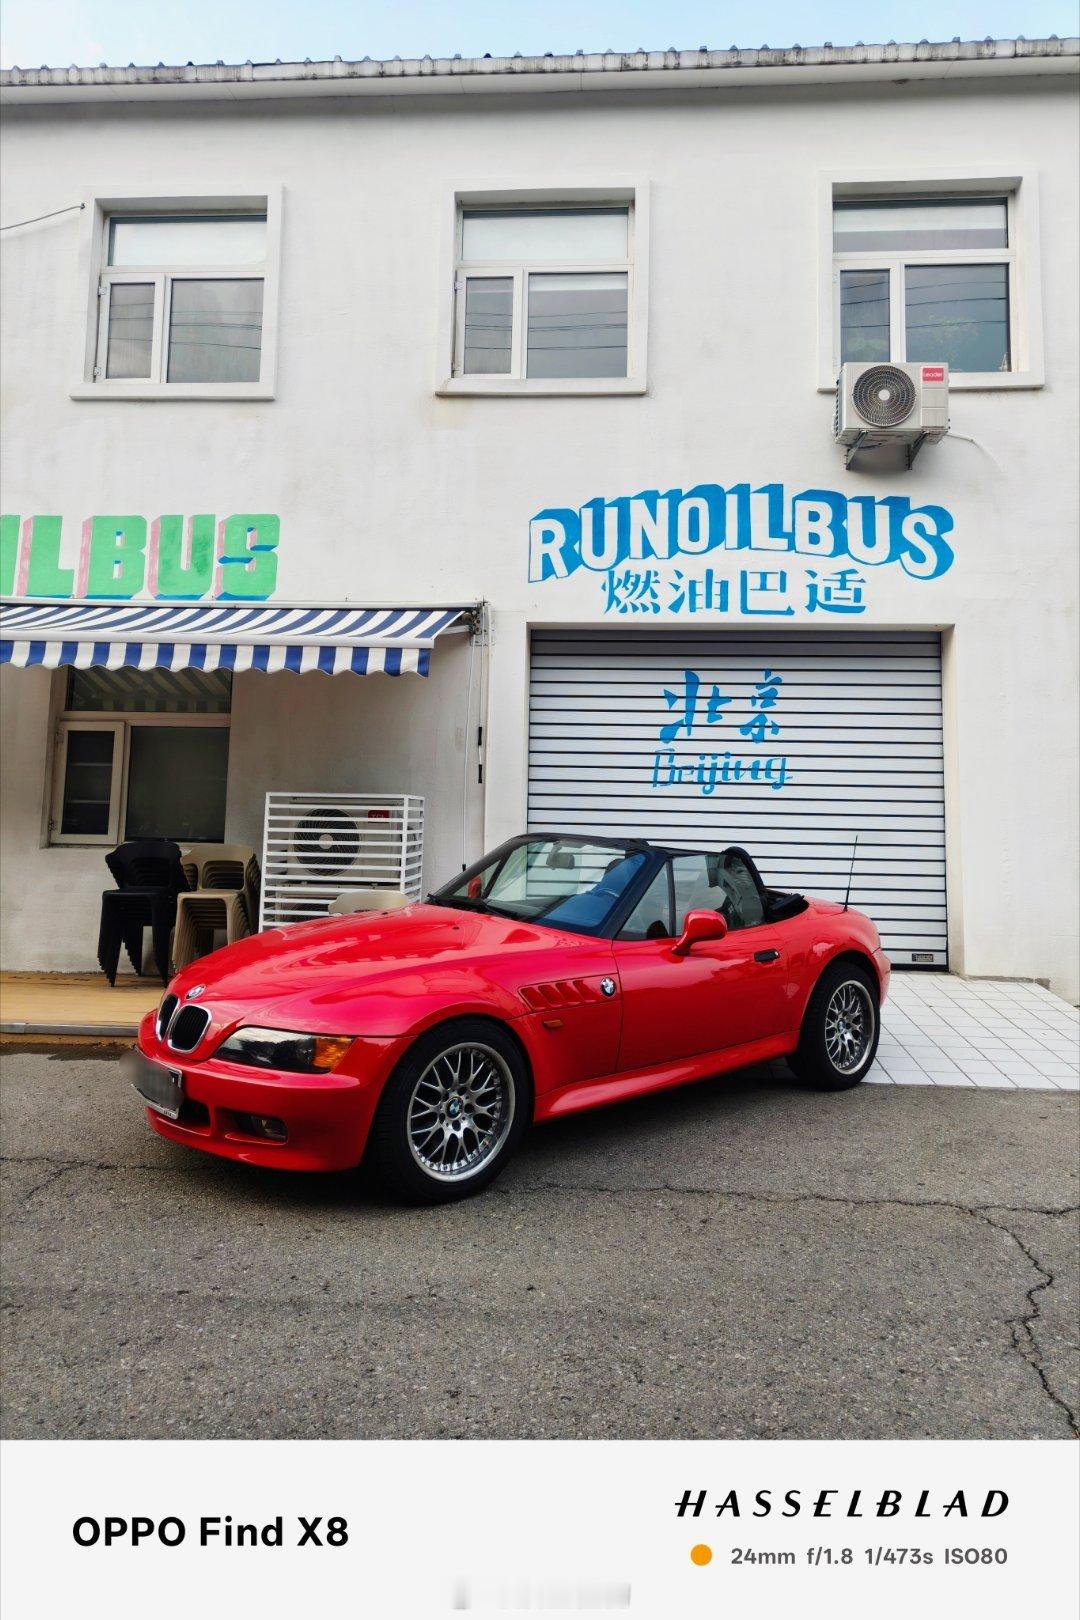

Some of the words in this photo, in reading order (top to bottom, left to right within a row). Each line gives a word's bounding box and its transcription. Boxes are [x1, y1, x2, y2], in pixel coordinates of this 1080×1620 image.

[528, 483, 955, 583] RUNOILBUS
[601, 568, 867, 616] 燃油巴适
[659, 669, 783, 744] 北京
[652, 748, 793, 795] Beijing
